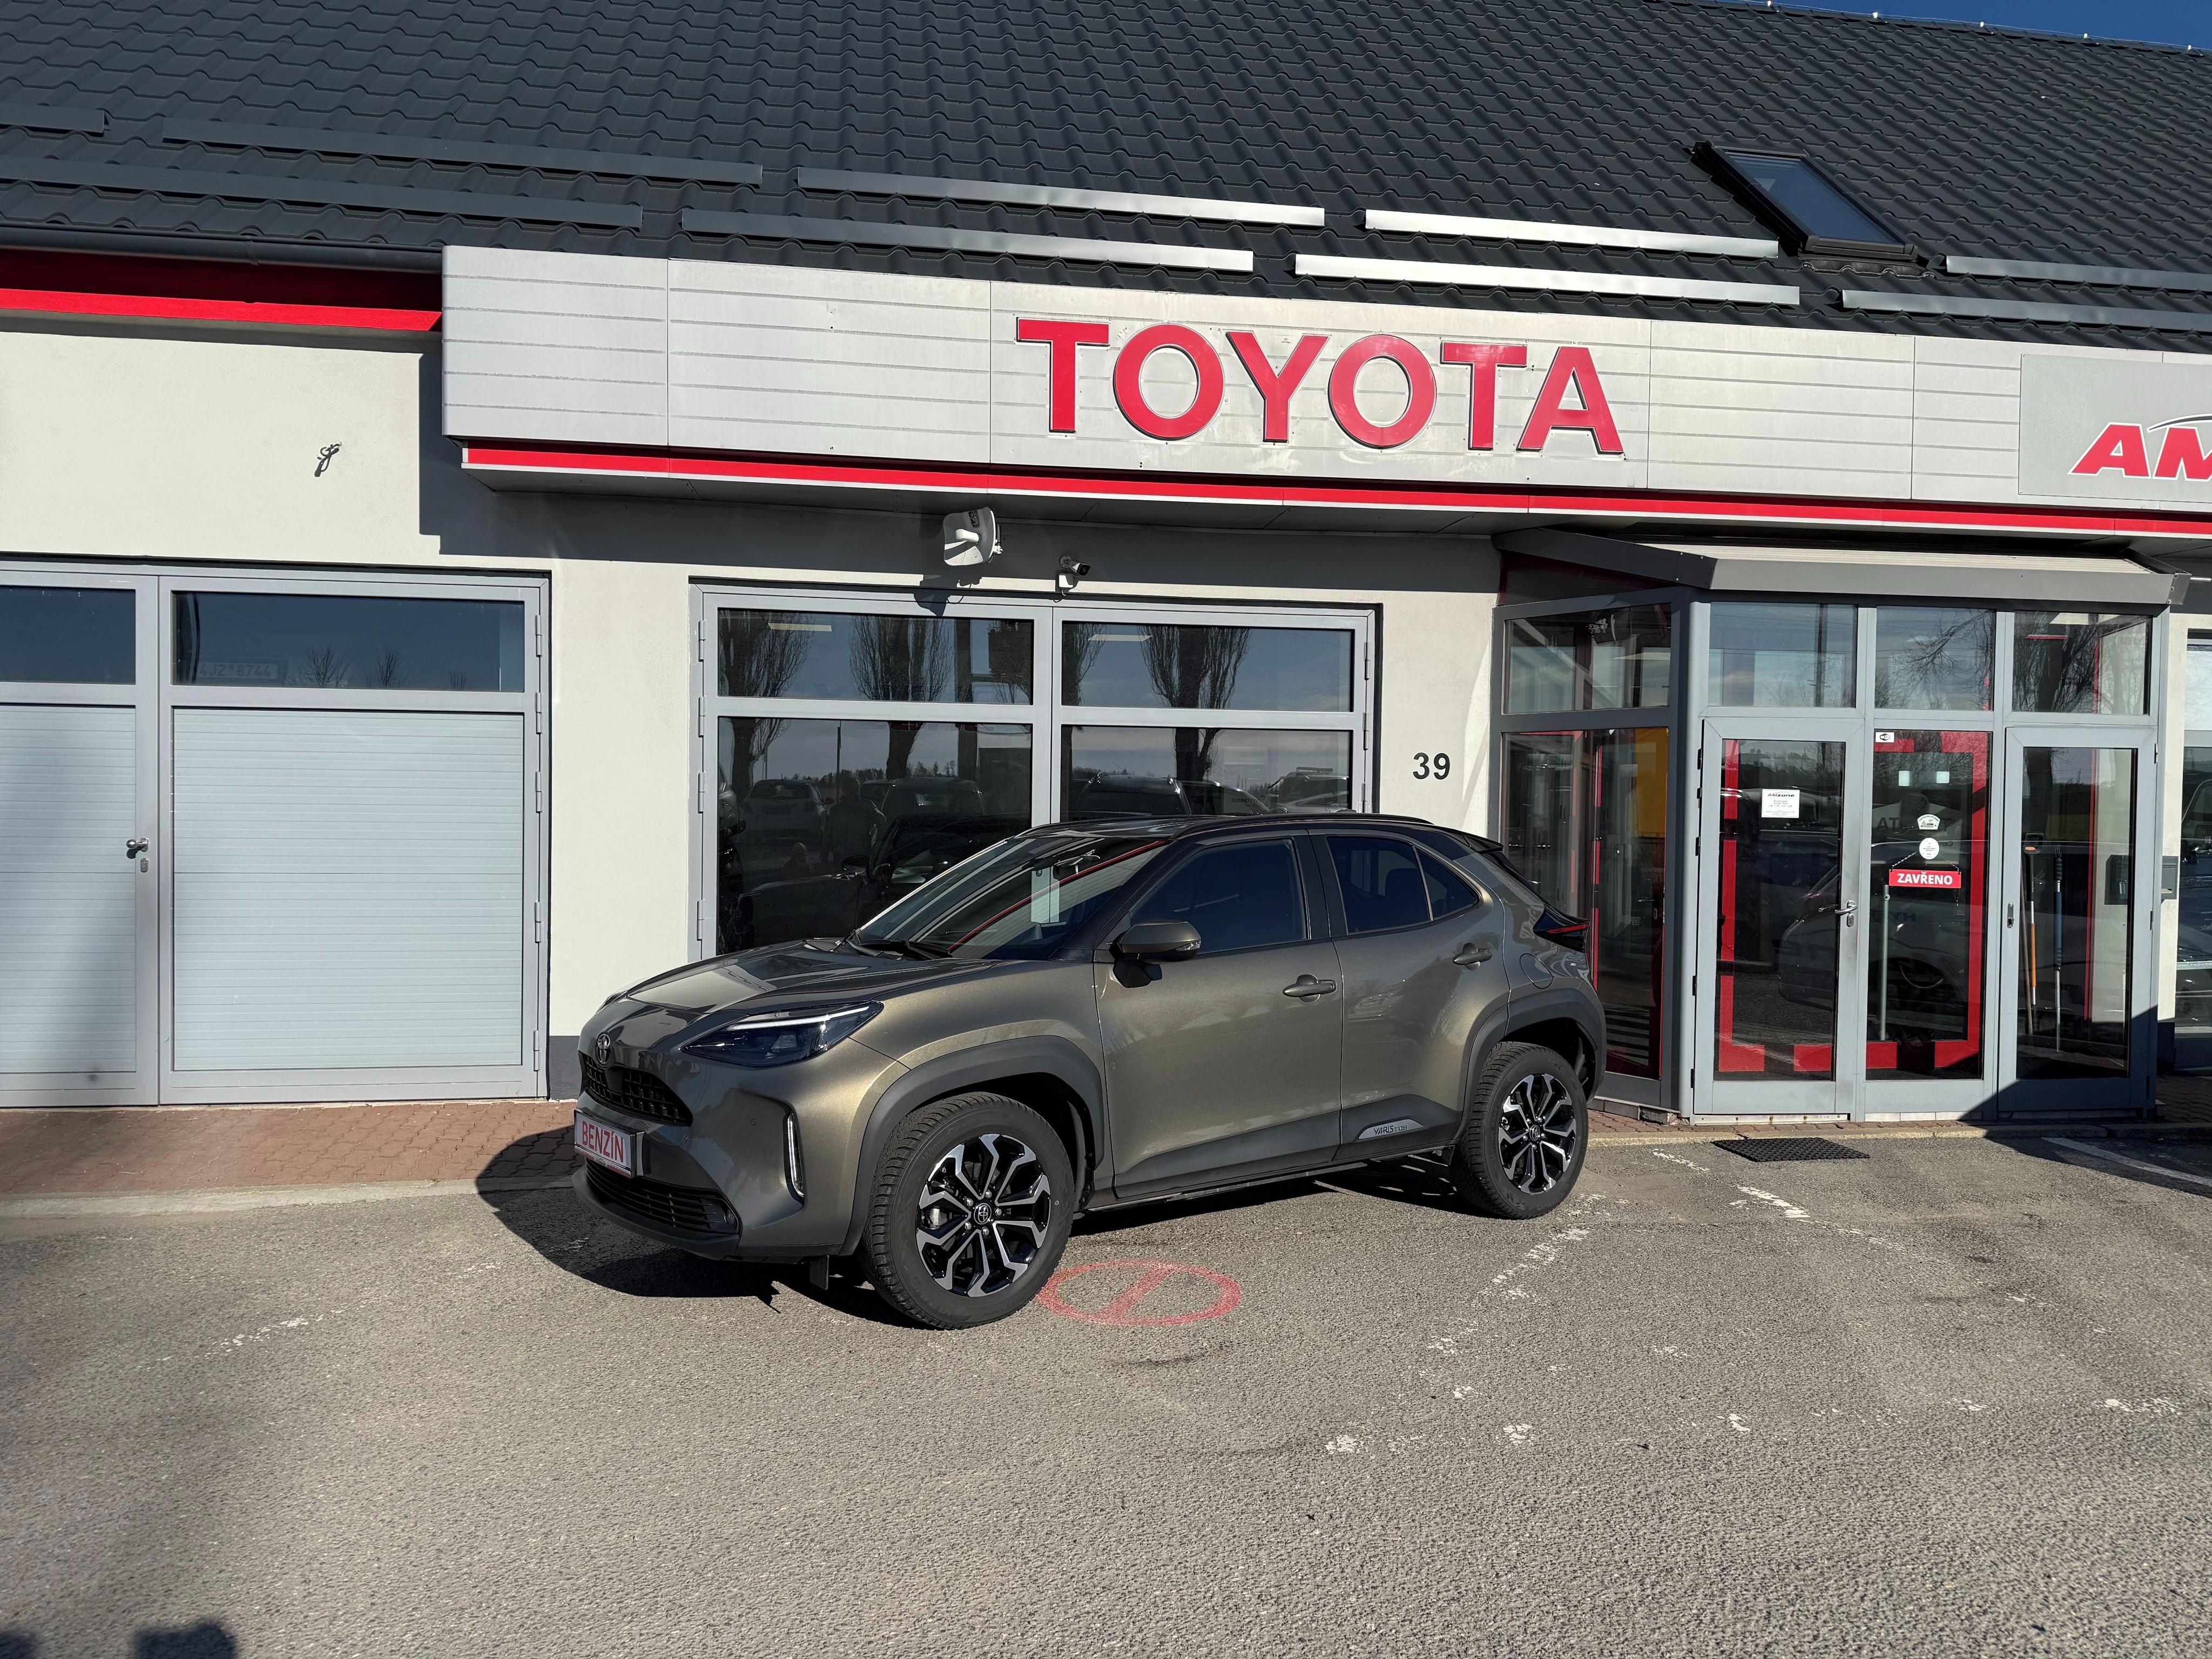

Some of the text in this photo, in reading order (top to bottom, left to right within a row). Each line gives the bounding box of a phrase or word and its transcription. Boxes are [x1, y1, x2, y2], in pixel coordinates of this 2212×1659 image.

[1016, 318, 1624, 454] TOYOTA
[237, 664, 272, 678] 8744
[1413, 752, 1451, 780] 39
[1897, 871, 1953, 885] ZAVŘENO
[1374, 1125, 1394, 1135] YARIS
